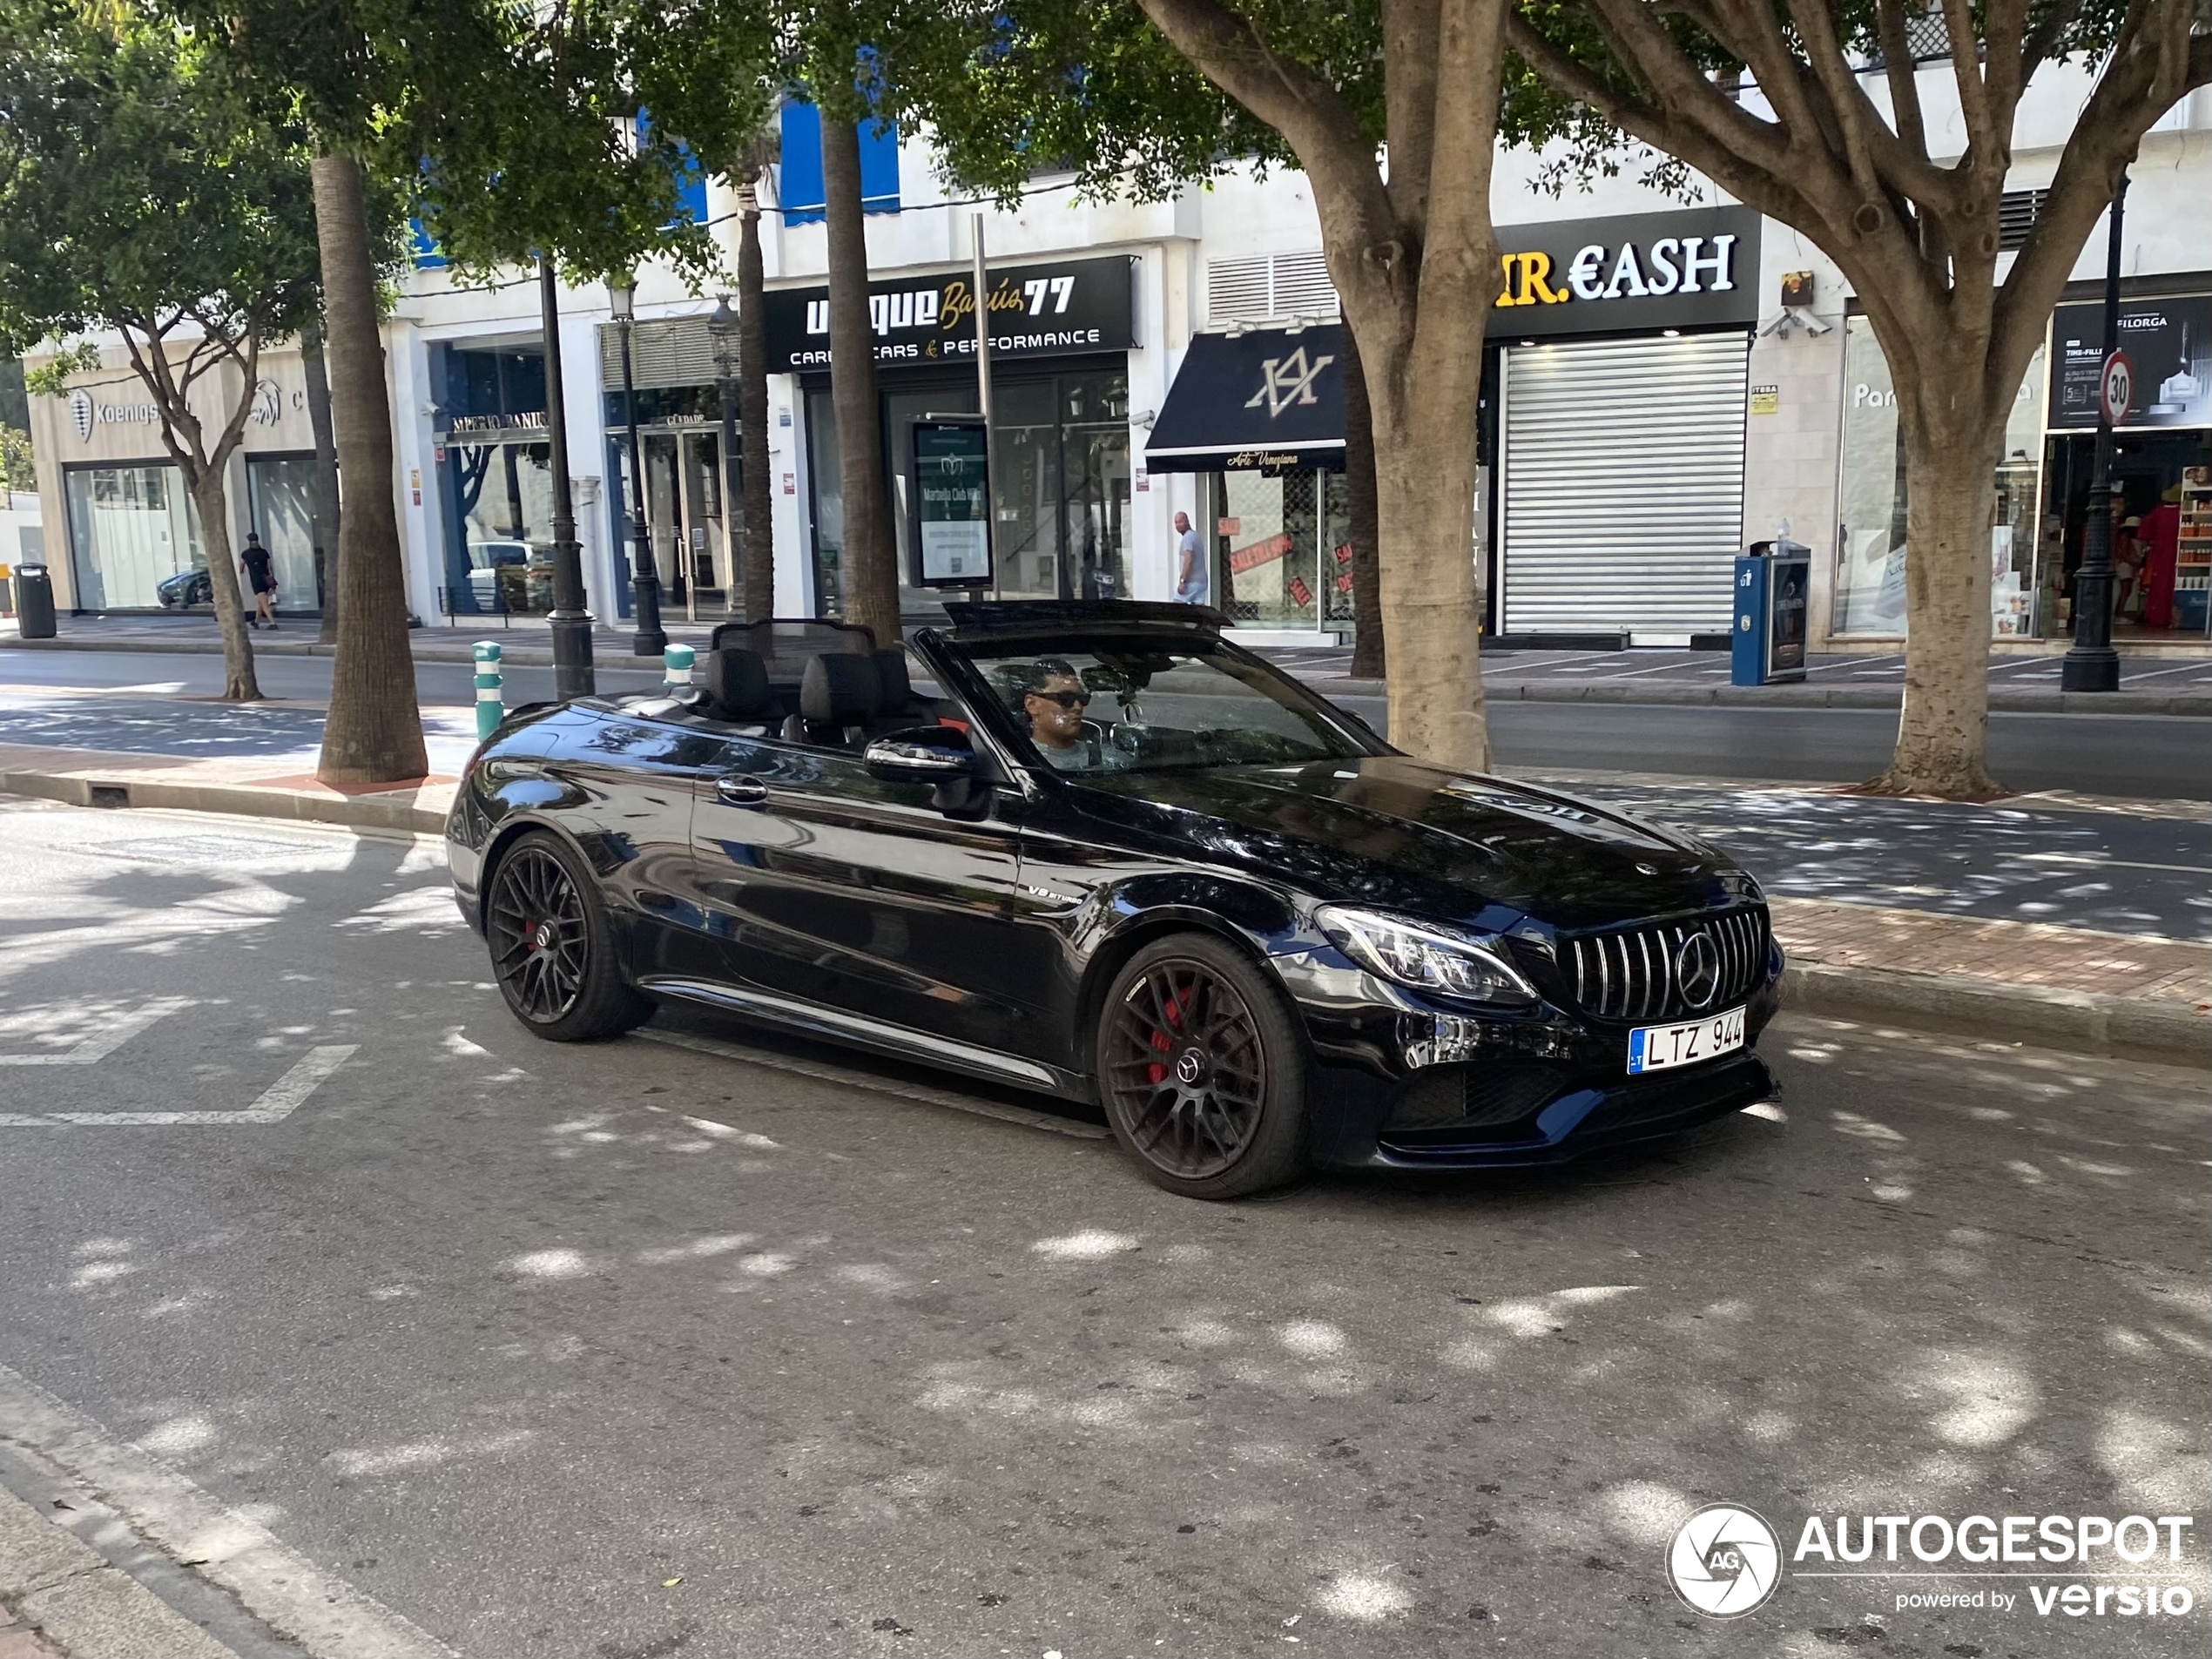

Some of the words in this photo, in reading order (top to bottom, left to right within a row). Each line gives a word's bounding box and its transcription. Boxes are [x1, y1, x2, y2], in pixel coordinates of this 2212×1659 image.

[1568, 234, 1736, 300] €ASH
[1024, 276, 1075, 315] 77
[2110, 374, 2127, 405] 30
[1290, 579, 1312, 607] SALE
[1028, 885, 1049, 897] V8
[1049, 893, 1083, 905] BITURBO
[1649, 1026, 1701, 1066] LTZ
[1713, 1013, 1742, 1051] 944
